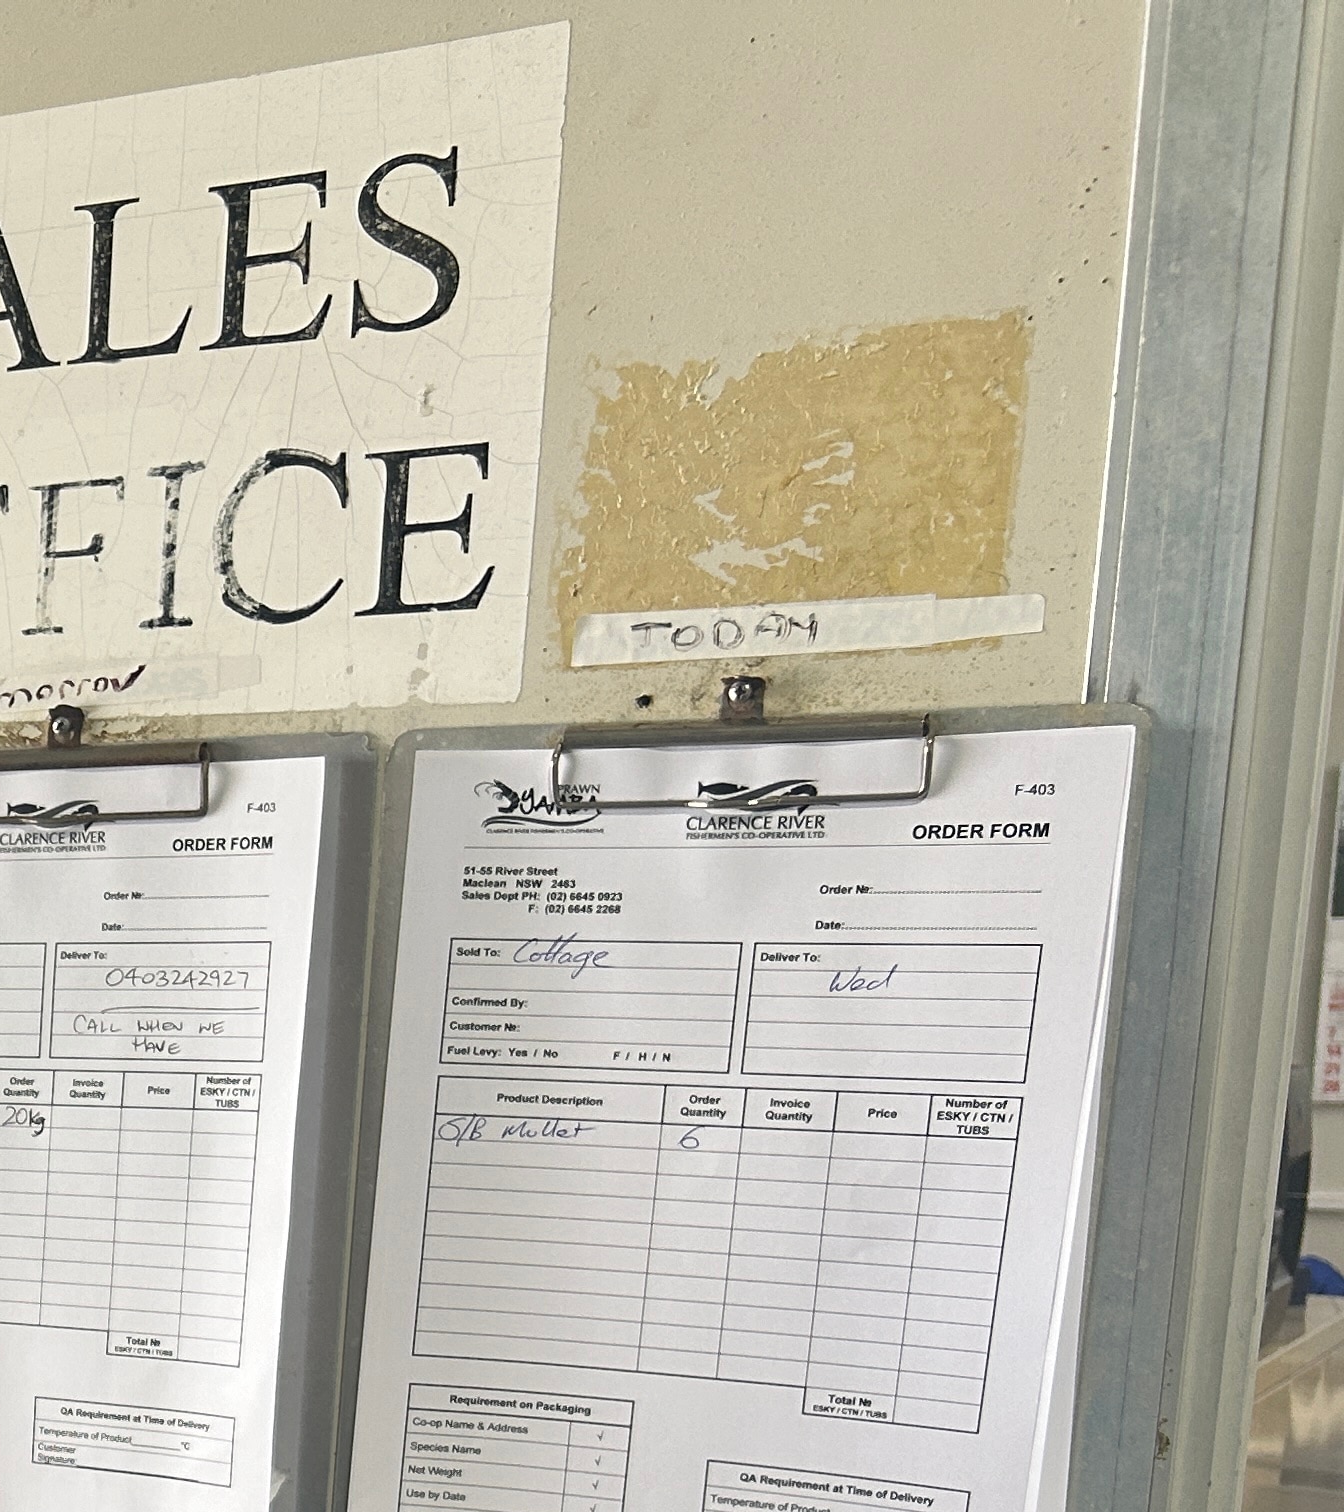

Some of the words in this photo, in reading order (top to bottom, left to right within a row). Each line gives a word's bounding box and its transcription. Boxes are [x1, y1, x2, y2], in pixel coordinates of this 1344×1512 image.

[631, 613, 818, 652] TODAY
[1015, 783, 1056, 796] F-403
[247, 802, 276, 813] F-403
[686, 816, 772, 831] CLARENCE
[777, 815, 825, 829] RIVER
[912, 824, 985, 840] ORDER
[989, 823, 1050, 838] FORM
[0, 832, 65, 846] CLARENCE
[69, 831, 105, 844] RIVER
[172, 838, 226, 851] ORDER
[230, 836, 274, 850] FORM
[464, 866, 493, 875] 51-55
[495, 867, 523, 875] River
[526, 867, 558, 876] Street
[463, 879, 507, 888] Maclean
[516, 880, 542, 888] NSW
[820, 885, 853, 894] Order
[462, 891, 491, 900] Sales
[494, 892, 518, 902] Dept
[521, 892, 540, 900] PH:
[547, 892, 567, 902] (02)
[569, 892, 595, 900] 6645
[597, 893, 623, 901] 0923
[528, 904, 539, 913] F:
[545, 904, 565, 915] (02)
[568, 905, 593, 913] 6645
[595, 905, 621, 913] 2268
[815, 920, 845, 930] Date:
[456, 947, 482, 957] Sold
[485, 947, 501, 957] To:
[513, 932, 612, 979] Cottage
[760, 952, 800, 963] Deliver
[803, 953, 821, 963] To:
[105, 968, 250, 990] 0403242927
[829, 964, 898, 992] Wed
[452, 997, 507, 1008] Confirmed
[510, 998, 528, 1009] By:
[73, 1014, 122, 1034] CALL
[449, 1022, 499, 1033] Customer
[447, 1045, 469, 1056] Fuel
[472, 1047, 501, 1058] Levy:
[508, 1048, 528, 1058] Yes
[543, 1049, 559, 1058] No
[496, 1093, 540, 1105] Product
[541, 1094, 603, 1107] Description
[689, 1094, 721, 1106] Order
[770, 1098, 810, 1109] Invoice
[945, 1098, 992, 1110] Number
[996, 1099, 1008, 1109] of
[680, 1106, 727, 1119] Quantity
[765, 1111, 813, 1124] Quantity
[868, 1109, 897, 1119] Price
[937, 1111, 971, 1122] ESKY
[980, 1112, 1004, 1123] CTN
[956, 1125, 989, 1135] TUBS
[678, 1125, 705, 1149] 6
[449, 1394, 517, 1409] Requirement
[519, 1400, 533, 1410] on
[536, 1401, 591, 1416] Packaging
[828, 1394, 855, 1406] Total
[412, 1417, 443, 1429] Co-op
[445, 1419, 475, 1430] Name
[477, 1421, 484, 1430] &
[487, 1422, 529, 1434] Address
[410, 1441, 449, 1454] Species
[452, 1444, 481, 1455] Name
[408, 1464, 426, 1475] Net
[428, 1466, 462, 1479] Weight
[406, 1488, 425, 1499] Use
[428, 1490, 440, 1502] by
[443, 1491, 466, 1501] Date
[740, 1472, 757, 1484] QA
[760, 1475, 830, 1492] Requirement
[833, 1483, 843, 1493] at
[846, 1484, 873, 1497] Time
[876, 1489, 887, 1499] of
[890, 1491, 934, 1508] Delivery
[711, 1494, 775, 1512] Temperature
[777, 1503, 788, 1512] of
